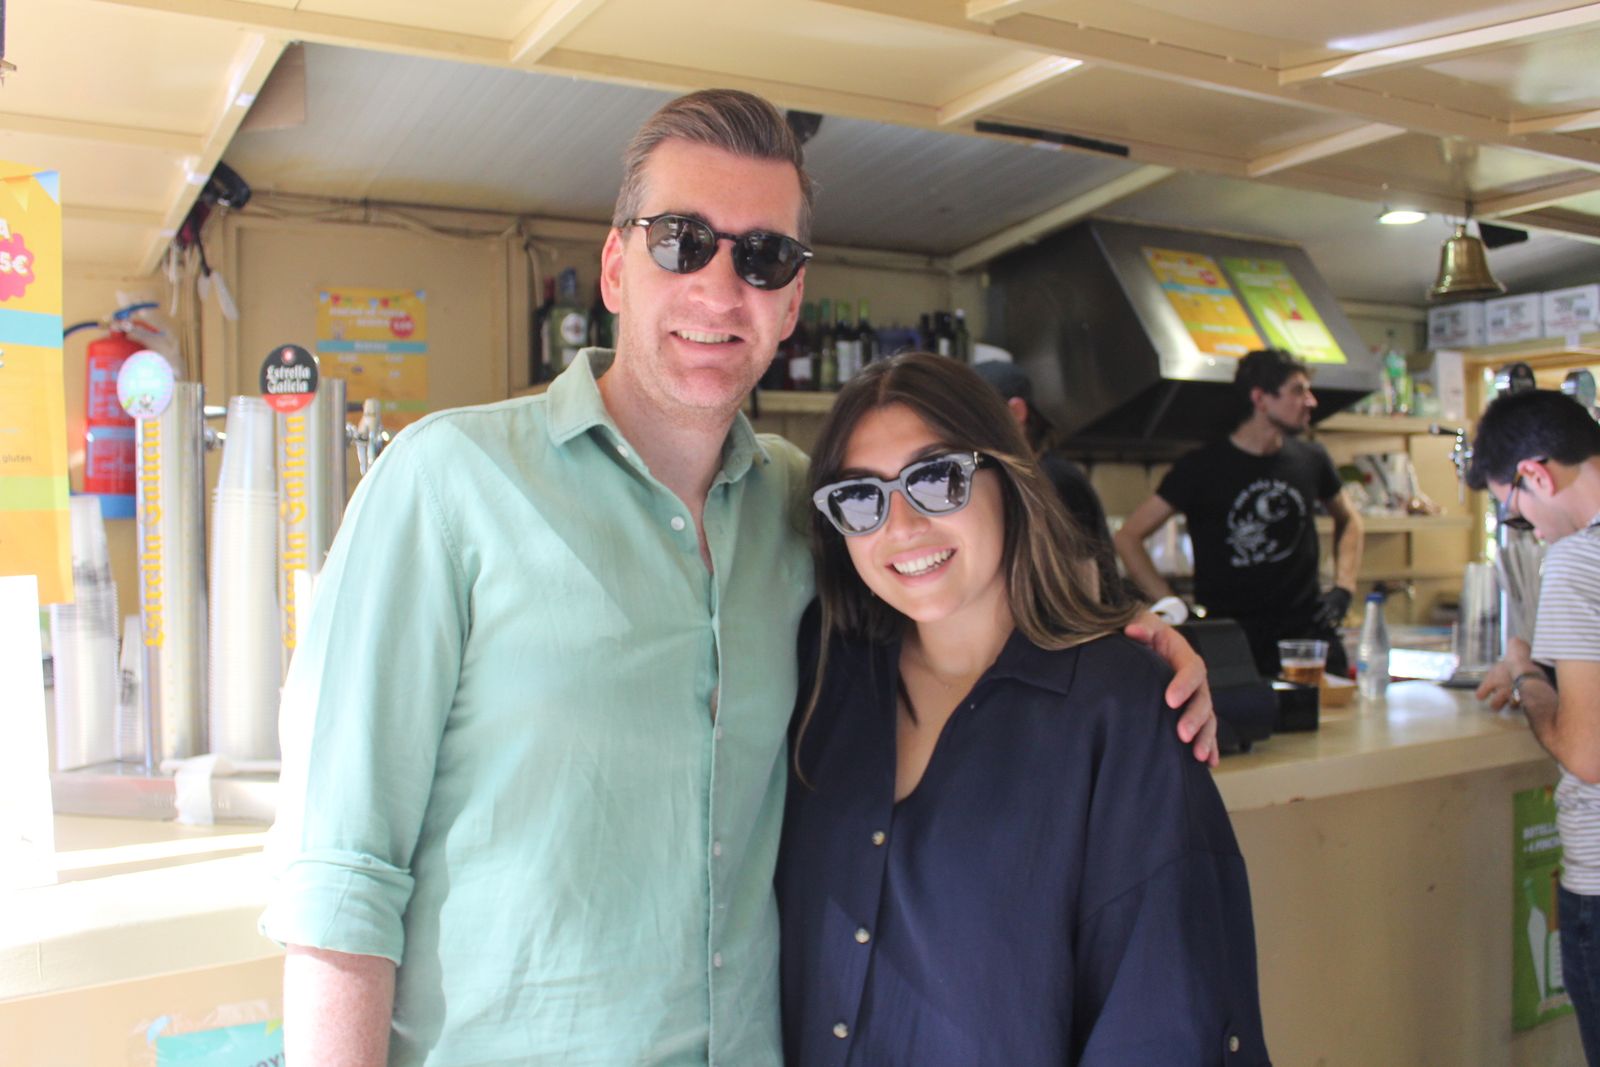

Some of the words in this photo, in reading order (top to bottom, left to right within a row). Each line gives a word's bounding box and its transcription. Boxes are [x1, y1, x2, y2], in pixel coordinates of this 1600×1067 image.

[266, 365, 311, 383] Estrella
[267, 379, 309, 394] Galicia
[2, 454, 32, 464] gluten
[140, 421, 162, 526] Galicia
[280, 416, 306, 525] Galicia
[140, 535, 164, 647] Estrella
